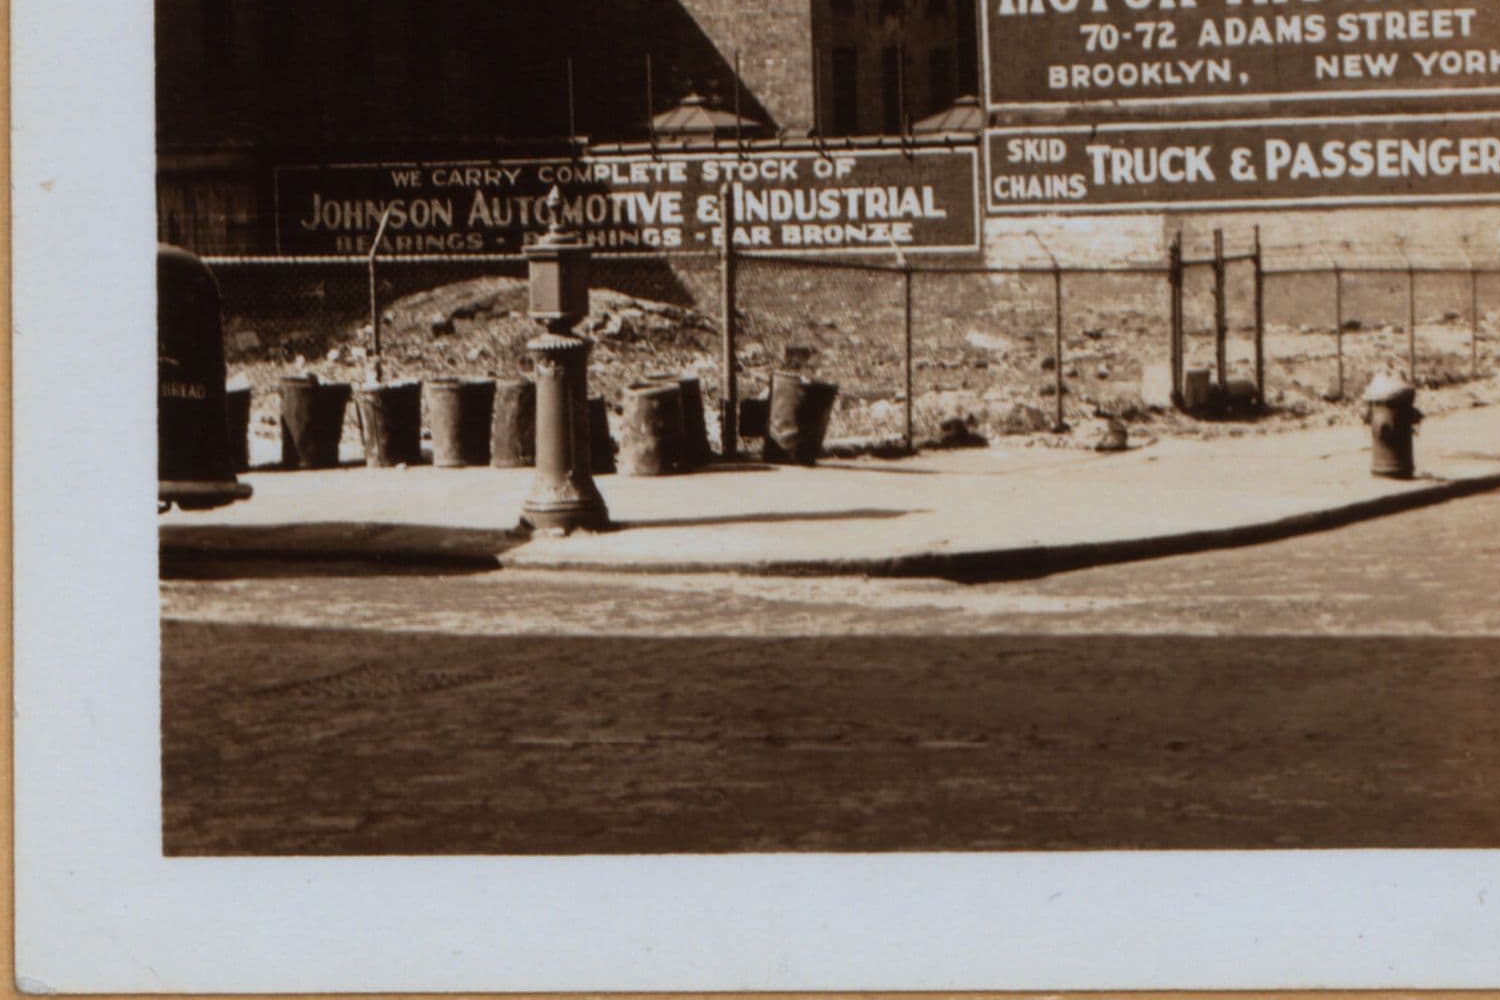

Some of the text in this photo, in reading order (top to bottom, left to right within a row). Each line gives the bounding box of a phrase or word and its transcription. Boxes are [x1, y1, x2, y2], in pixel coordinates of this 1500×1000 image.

[1080, 9, 1476, 53] 70-72 ADAMS STREET
[1315, 53, 1400, 79] NEW
[1007, 139, 1066, 163] SKID
[392, 159, 856, 187] WE CARRY COMPLETE STOCK OF
[1087, 146, 1214, 186] TRUCK
[1230, 149, 1257, 181] &
[994, 174, 1087, 200] CHAINS
[301, 193, 452, 231] JOHNSON
[467, 189, 683, 227] AUTOMOTIVE
[733, 182, 946, 222] INDUSTRIAL
[782, 223, 913, 246] BRONZE
